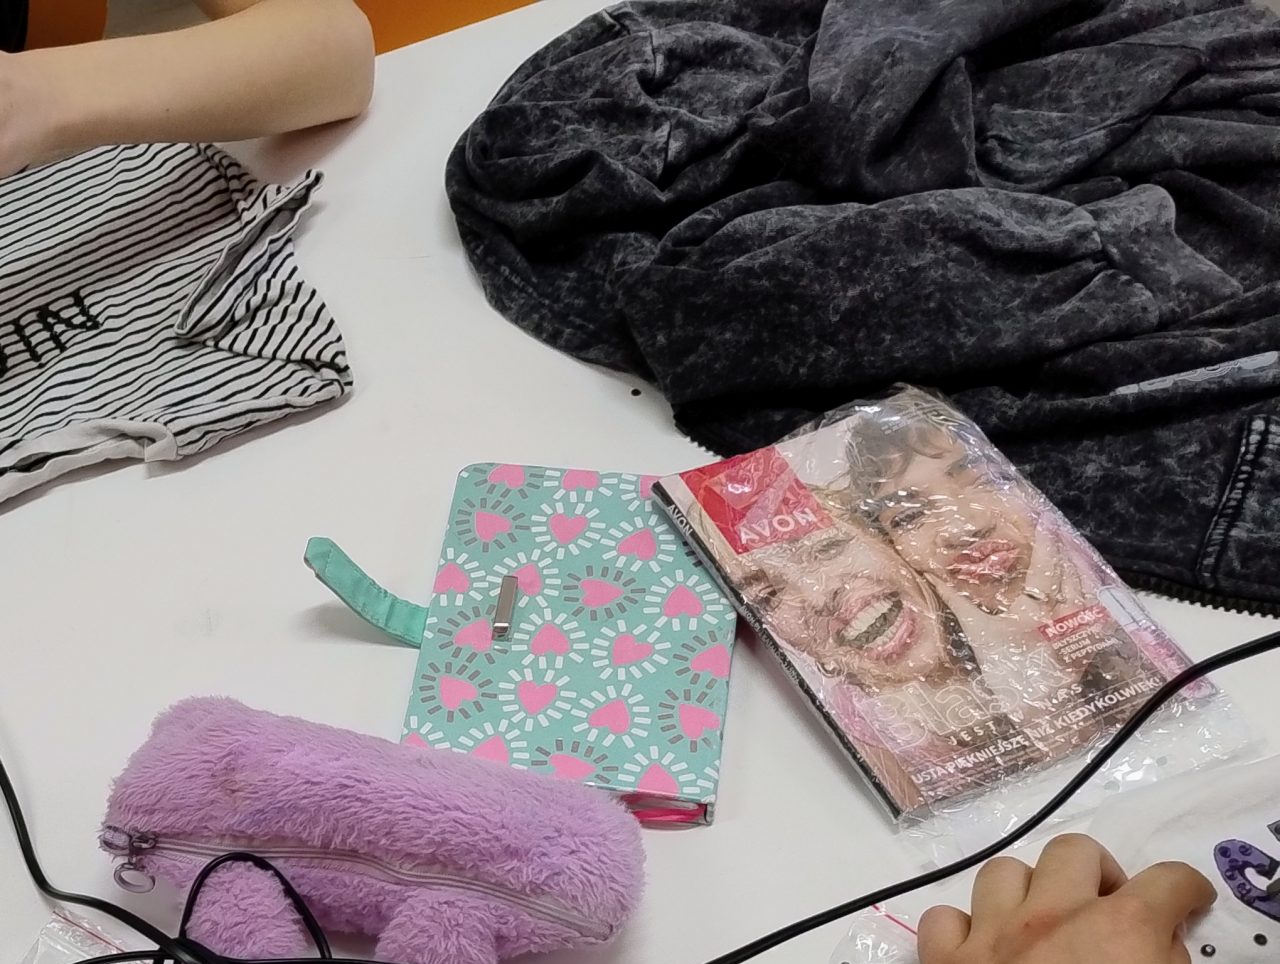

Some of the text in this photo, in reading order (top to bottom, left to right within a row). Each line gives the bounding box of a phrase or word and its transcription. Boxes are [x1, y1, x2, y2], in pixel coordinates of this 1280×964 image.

[669, 503, 693, 537] AVON
[738, 507, 817, 544] AVON
[911, 765, 947, 784] USTA
[1053, 675, 1162, 730] KIEDYKOLWIEK!
[948, 721, 997, 746] JEST
